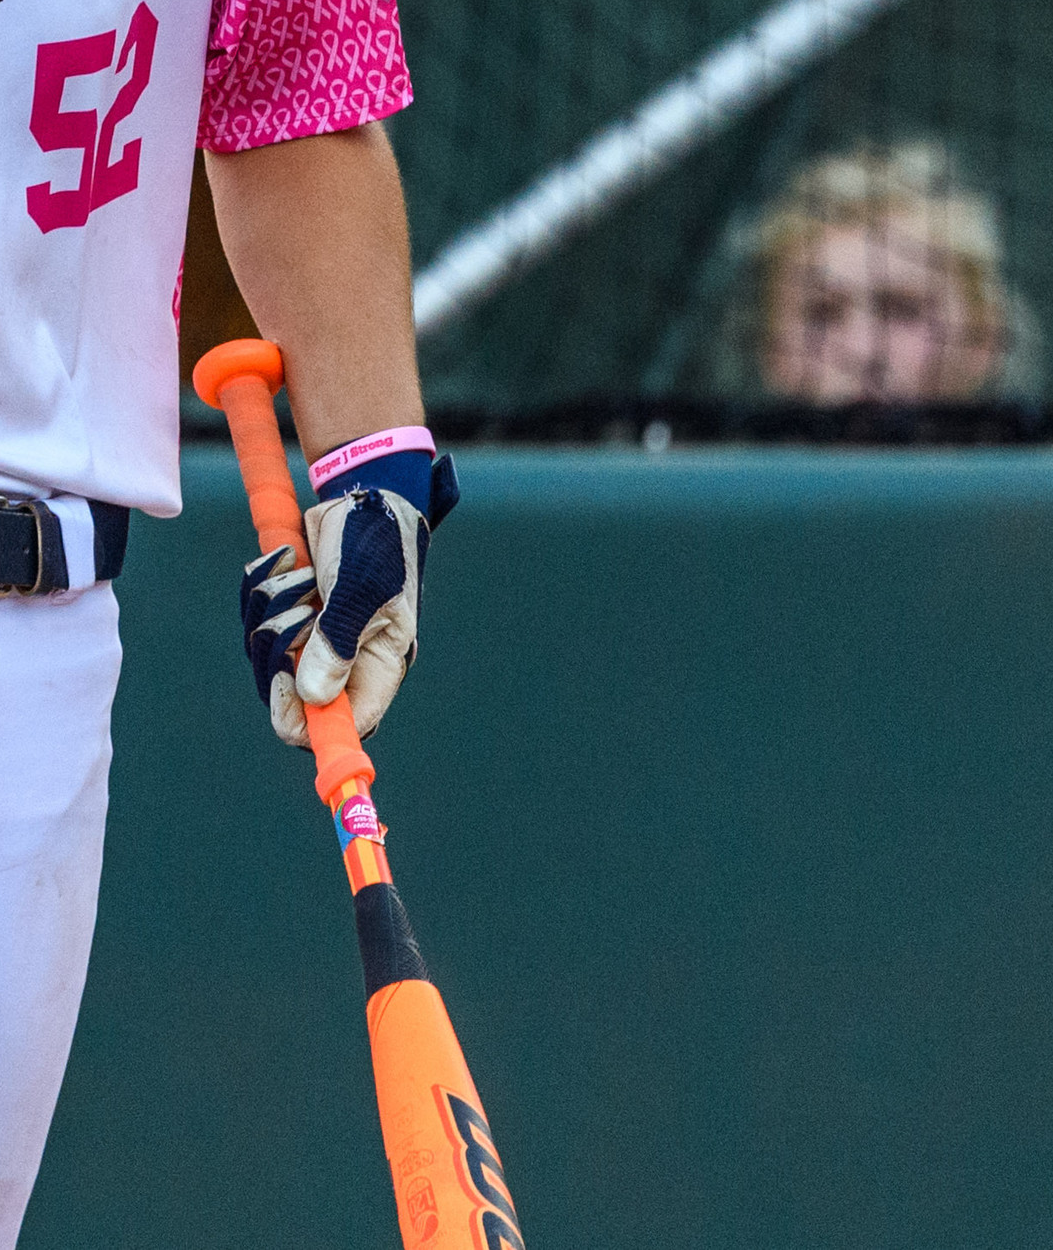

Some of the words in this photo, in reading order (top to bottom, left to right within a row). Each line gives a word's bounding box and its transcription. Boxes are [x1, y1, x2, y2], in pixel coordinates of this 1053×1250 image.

[25, 0, 160, 235] 52
[314, 456, 341, 478] Super
[343, 451, 348, 464] J
[350, 436, 393, 458] Strong
